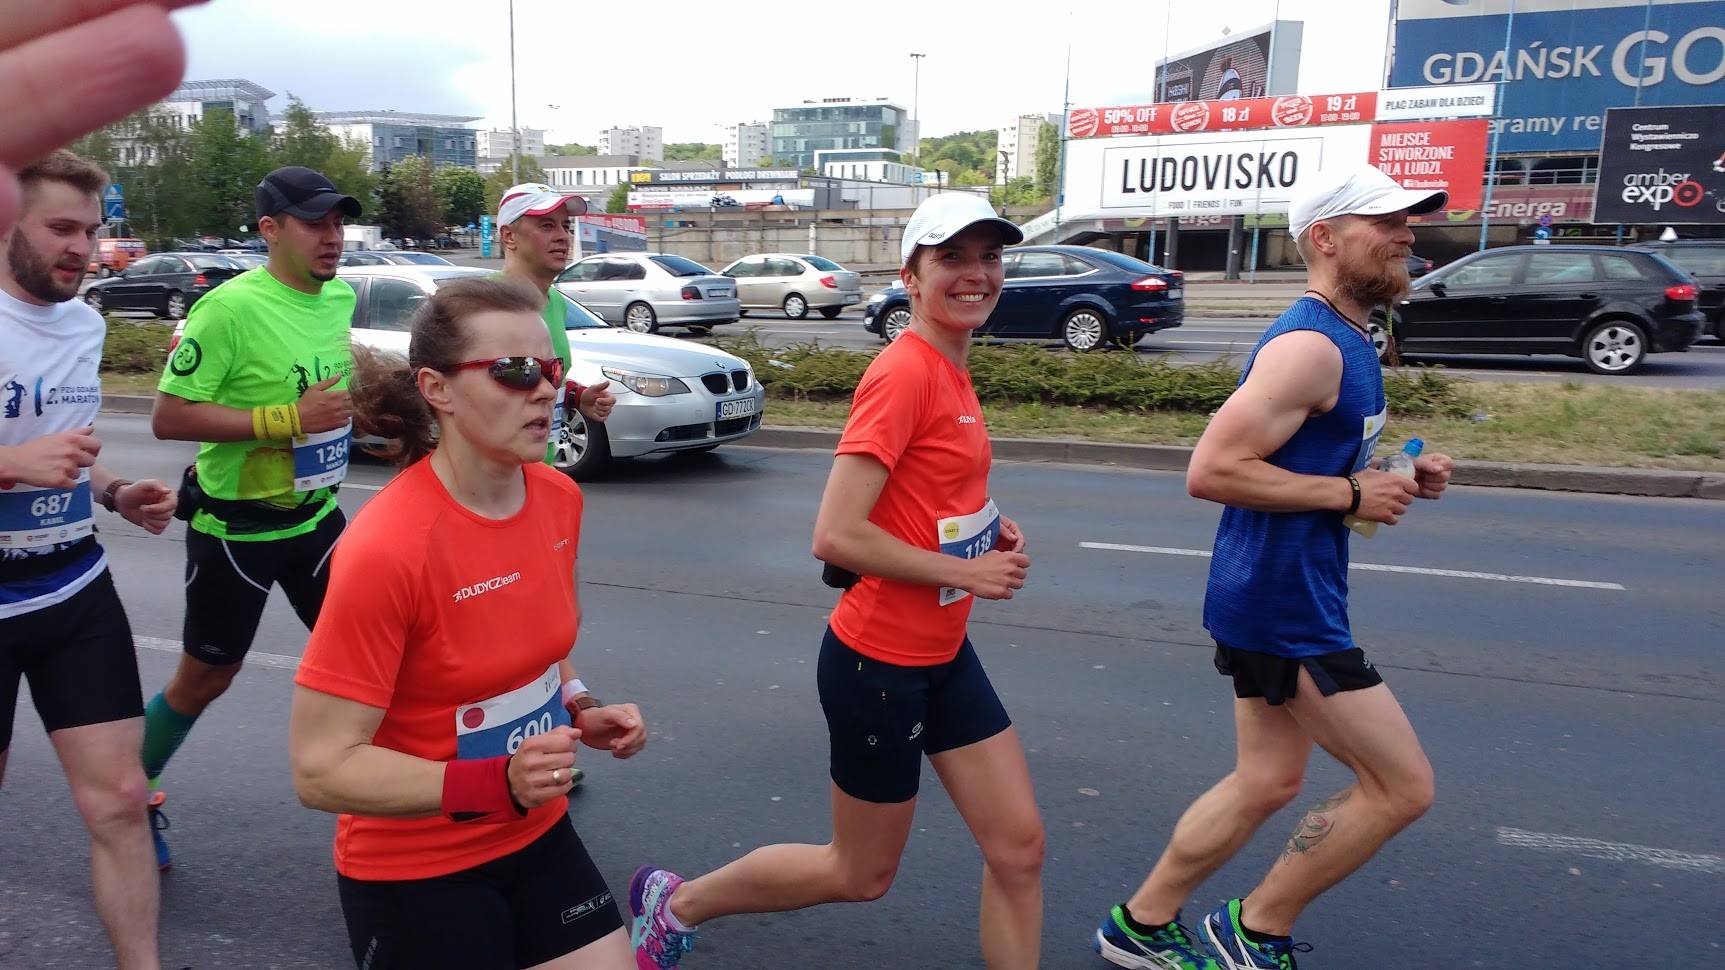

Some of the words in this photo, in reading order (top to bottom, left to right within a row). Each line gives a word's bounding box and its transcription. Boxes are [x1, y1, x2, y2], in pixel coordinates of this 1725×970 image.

[1423, 41, 1605, 85] GDAŃSK
[1326, 96, 1343, 112] 19
[1385, 100, 1408, 110] PLAC
[1408, 98, 1438, 109] ZABAW
[1439, 97, 1455, 107] DLA
[1457, 95, 1485, 106] DZIECI
[1103, 109, 1134, 124] 50%
[1136, 107, 1158, 122] OFF
[1221, 107, 1236, 123] 18
[1380, 132, 1432, 147] MIEJSCE
[1378, 145, 1456, 161] STWORZONE
[1121, 149, 1299, 194] LUDOVISKO
[1378, 162, 1402, 176] DLA
[1403, 161, 1444, 175] LUDZI.
[1623, 167, 1691, 186] amber
[1193, 200, 1220, 208] FRIENDS
[1229, 199, 1243, 207] FUN
[1621, 180, 1705, 211] expo
[1484, 200, 1567, 219] Energa
[722, 402, 734, 416] GD
[316, 439, 348, 464] 1264
[31, 492, 73, 517] 687
[965, 529, 992, 560] 1138
[506, 711, 553, 755] 600
